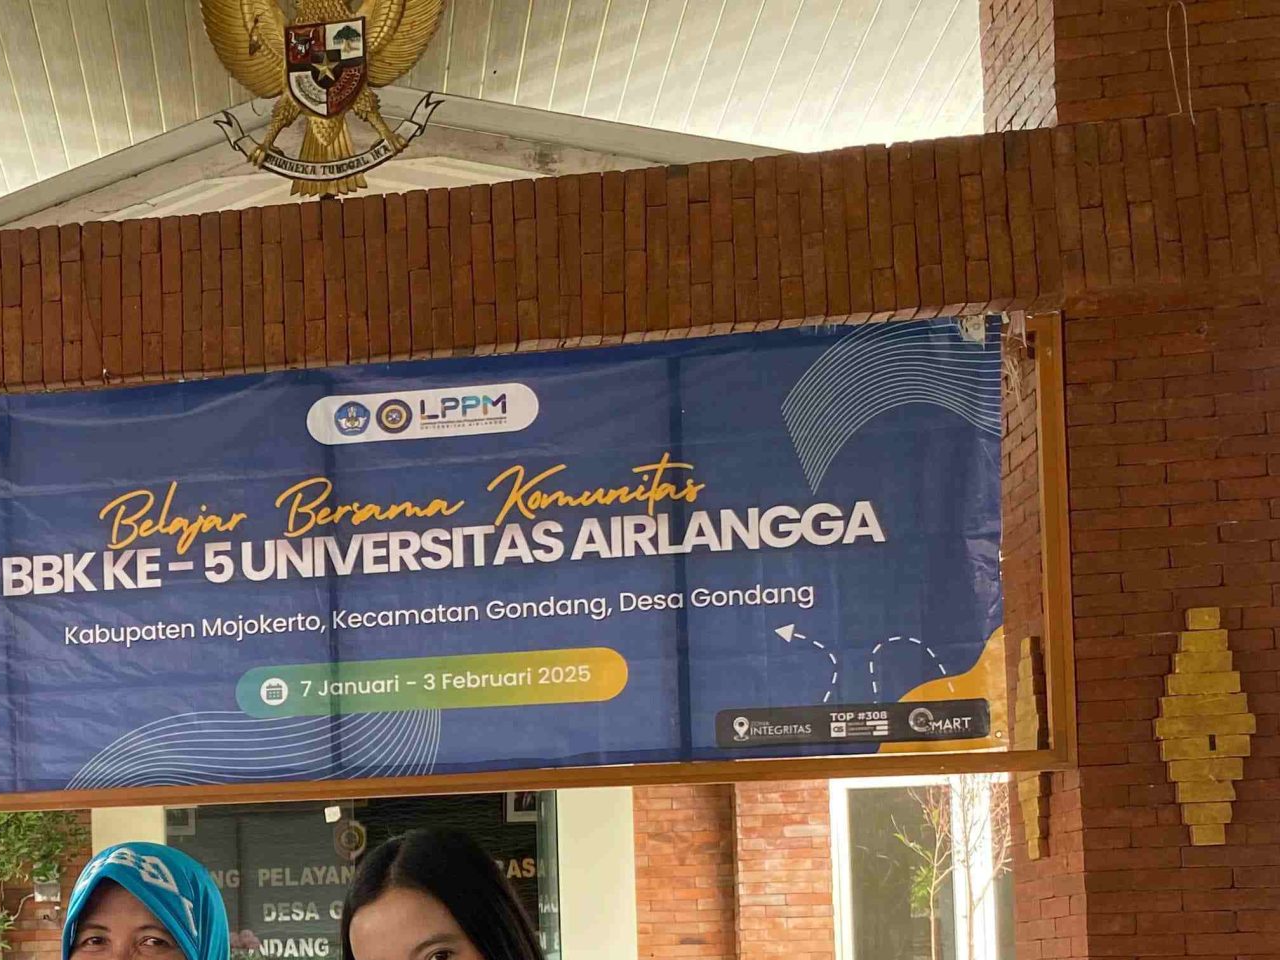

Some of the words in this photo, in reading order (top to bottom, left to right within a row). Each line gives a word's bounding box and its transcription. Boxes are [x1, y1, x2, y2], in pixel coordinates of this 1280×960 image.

[371, 143, 391, 161] IKA
[420, 393, 507, 419] LPPM
[99, 481, 247, 554] Belajar
[275, 477, 464, 537] Bersama
[487, 452, 705, 526] Komunitas
[2, 552, 97, 597] BBK
[103, 548, 162, 590] KE
[204, 541, 234, 583] 5
[241, 520, 564, 582] UNIVERSITAS
[571, 500, 886, 560] AIRLANGGA
[65, 621, 195, 647] Kabupaten
[202, 612, 326, 641] Mojokerto,
[333, 603, 478, 629] Kecamatan
[486, 595, 613, 621] Gondang,
[620, 590, 683, 612] Desa
[690, 584, 815, 608] Gondang
[300, 680, 312, 697] 7
[318, 675, 399, 697] Januari
[423, 673, 435, 690] 3
[442, 667, 532, 690] Februari
[538, 665, 591, 684] 2025
[830, 712, 854, 721] TOP
[857, 711, 888, 720] #308
[750, 724, 812, 736] INTEGRITAS
[258, 865, 357, 888] PELAYAN
[263, 901, 320, 922] DESA
[249, 937, 329, 958] NDANG
